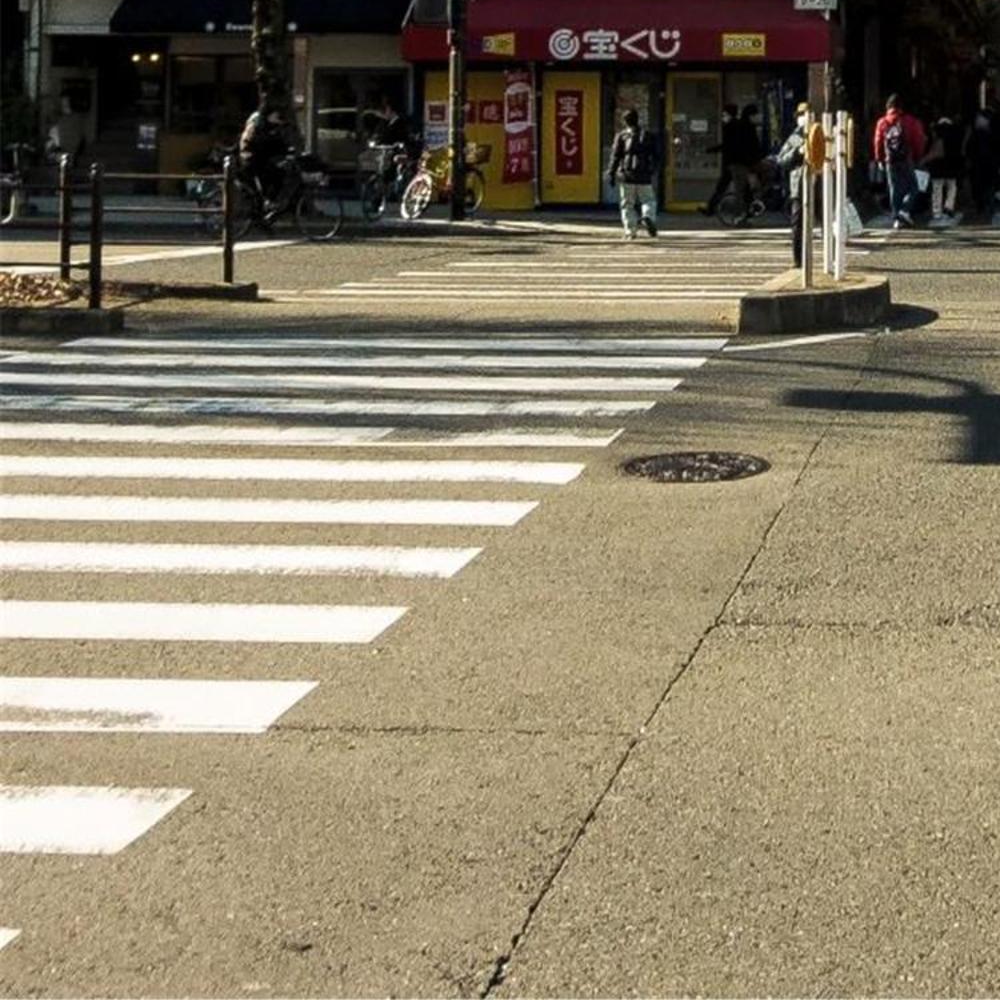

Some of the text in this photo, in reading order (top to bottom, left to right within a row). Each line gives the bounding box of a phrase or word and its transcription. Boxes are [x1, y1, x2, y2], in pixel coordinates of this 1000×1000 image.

[582, 28, 681, 60] 宝くじ
[557, 96, 579, 157] 宝くじ
